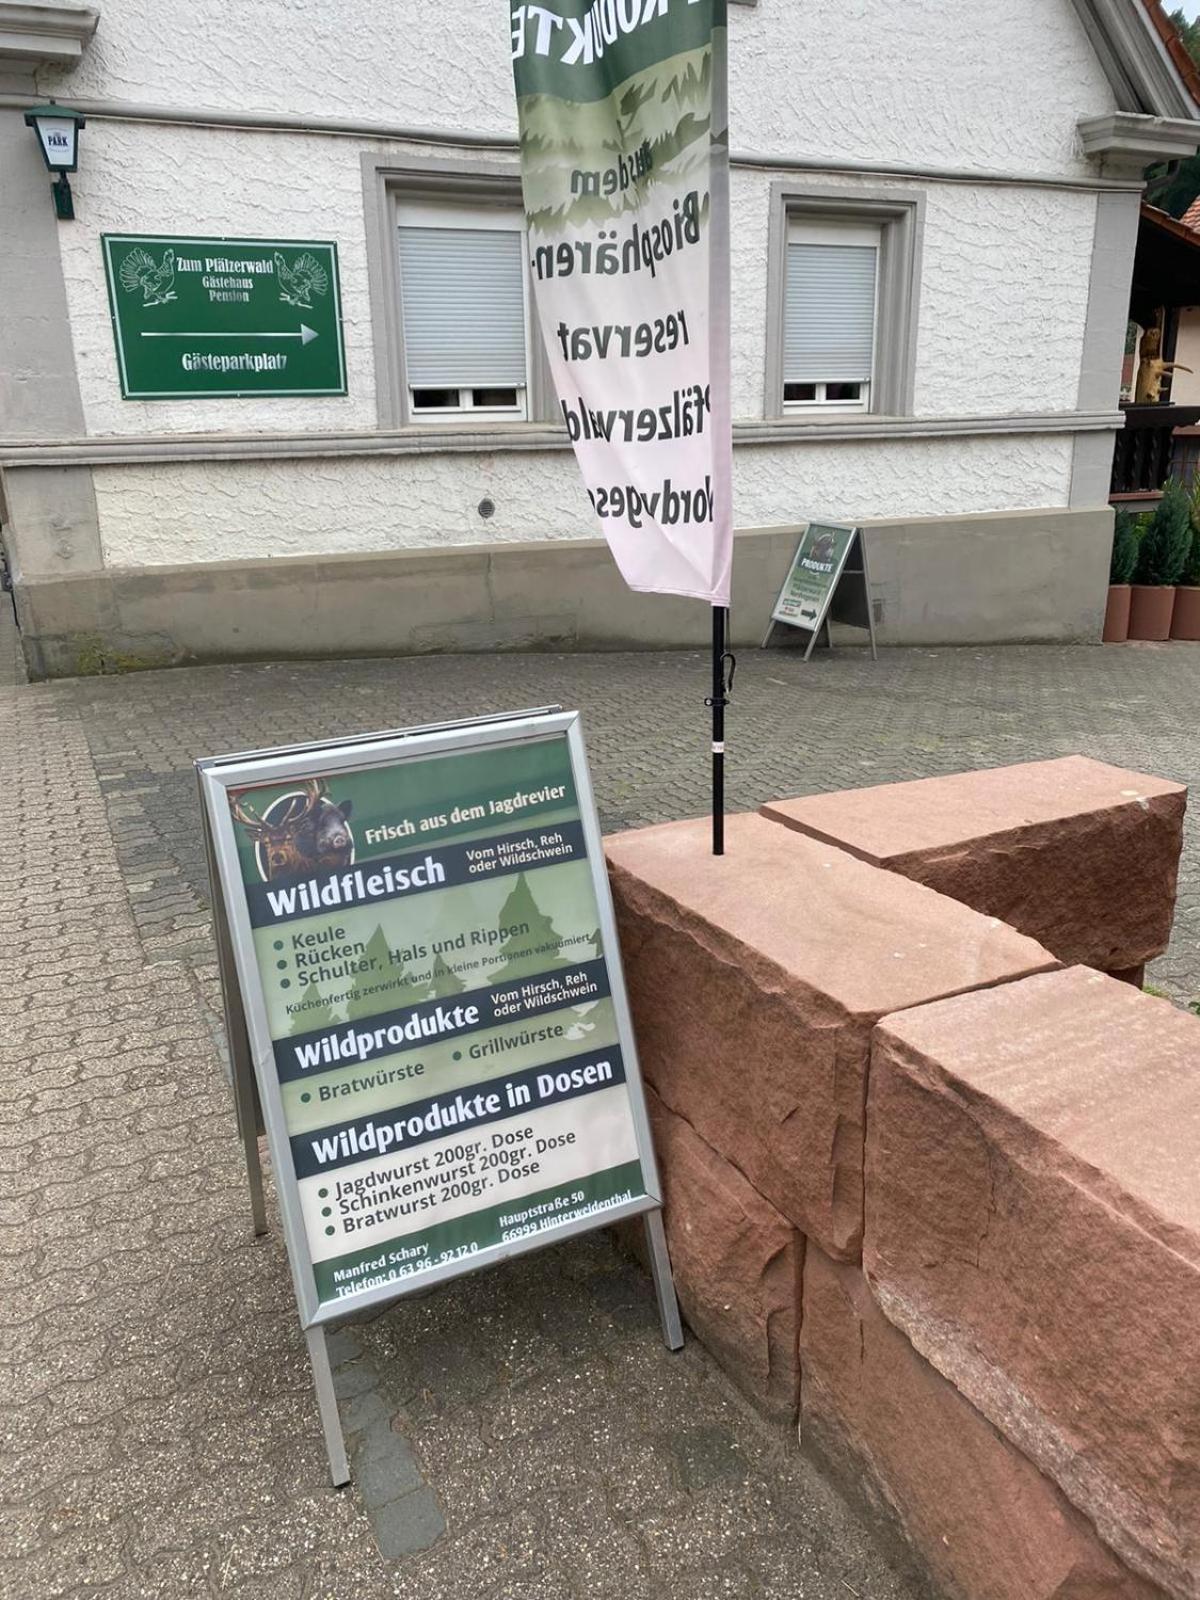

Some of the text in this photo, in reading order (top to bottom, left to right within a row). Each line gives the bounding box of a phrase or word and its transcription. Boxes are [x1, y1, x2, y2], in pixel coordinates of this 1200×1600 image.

[47, 135, 68, 147] PARK
[176, 257, 274, 273] Zum Pfälzerwald
[202, 275, 254, 289] Gästehaus
[208, 289, 250, 302] Pension
[181, 352, 288, 372] Gästeparkplatz
[801, 557, 833, 573] PRODUKTE
[365, 784, 566, 845] Frisch aus dem Jagdrevier
[466, 833, 563, 861] Vom Hirsch, Reh
[468, 843, 573, 874] oder Wildschwein
[266, 856, 446, 917] Wildfleisch
[292, 926, 346, 950] Keule
[295, 942, 366, 968] Rücken
[297, 922, 530, 987] Schulter, Hals und Rippen
[362, 976, 410, 996] zerwirkt
[411, 971, 432, 984] und
[434, 967, 445, 979] in
[446, 960, 480, 975] kleine
[481, 946, 533, 967] Portionen
[490, 971, 588, 1005] Vom Hirsch, Reh
[494, 981, 598, 1017] oder Wildschwein
[294, 1005, 480, 1069] Wildprodukte
[468, 1024, 564, 1060] Grillwürste
[318, 1063, 425, 1101] Bratwürste
[311, 1060, 613, 1164] Wildprodukte in Dosen
[335, 1127, 534, 1201] Jagdwurst 200gr. Dose
[339, 1131, 576, 1215] Schinkenwurst 200gr. Dose
[342, 1162, 540, 1233] Bratwurst 200gr. Dose
[499, 1190, 585, 1228] Hauptstraße 50
[501, 1222, 538, 1243] 66999
[333, 1242, 430, 1283] Manfred Schary
[335, 1272, 387, 1299] Telefon:
[416, 1257, 432, 1272] 96
